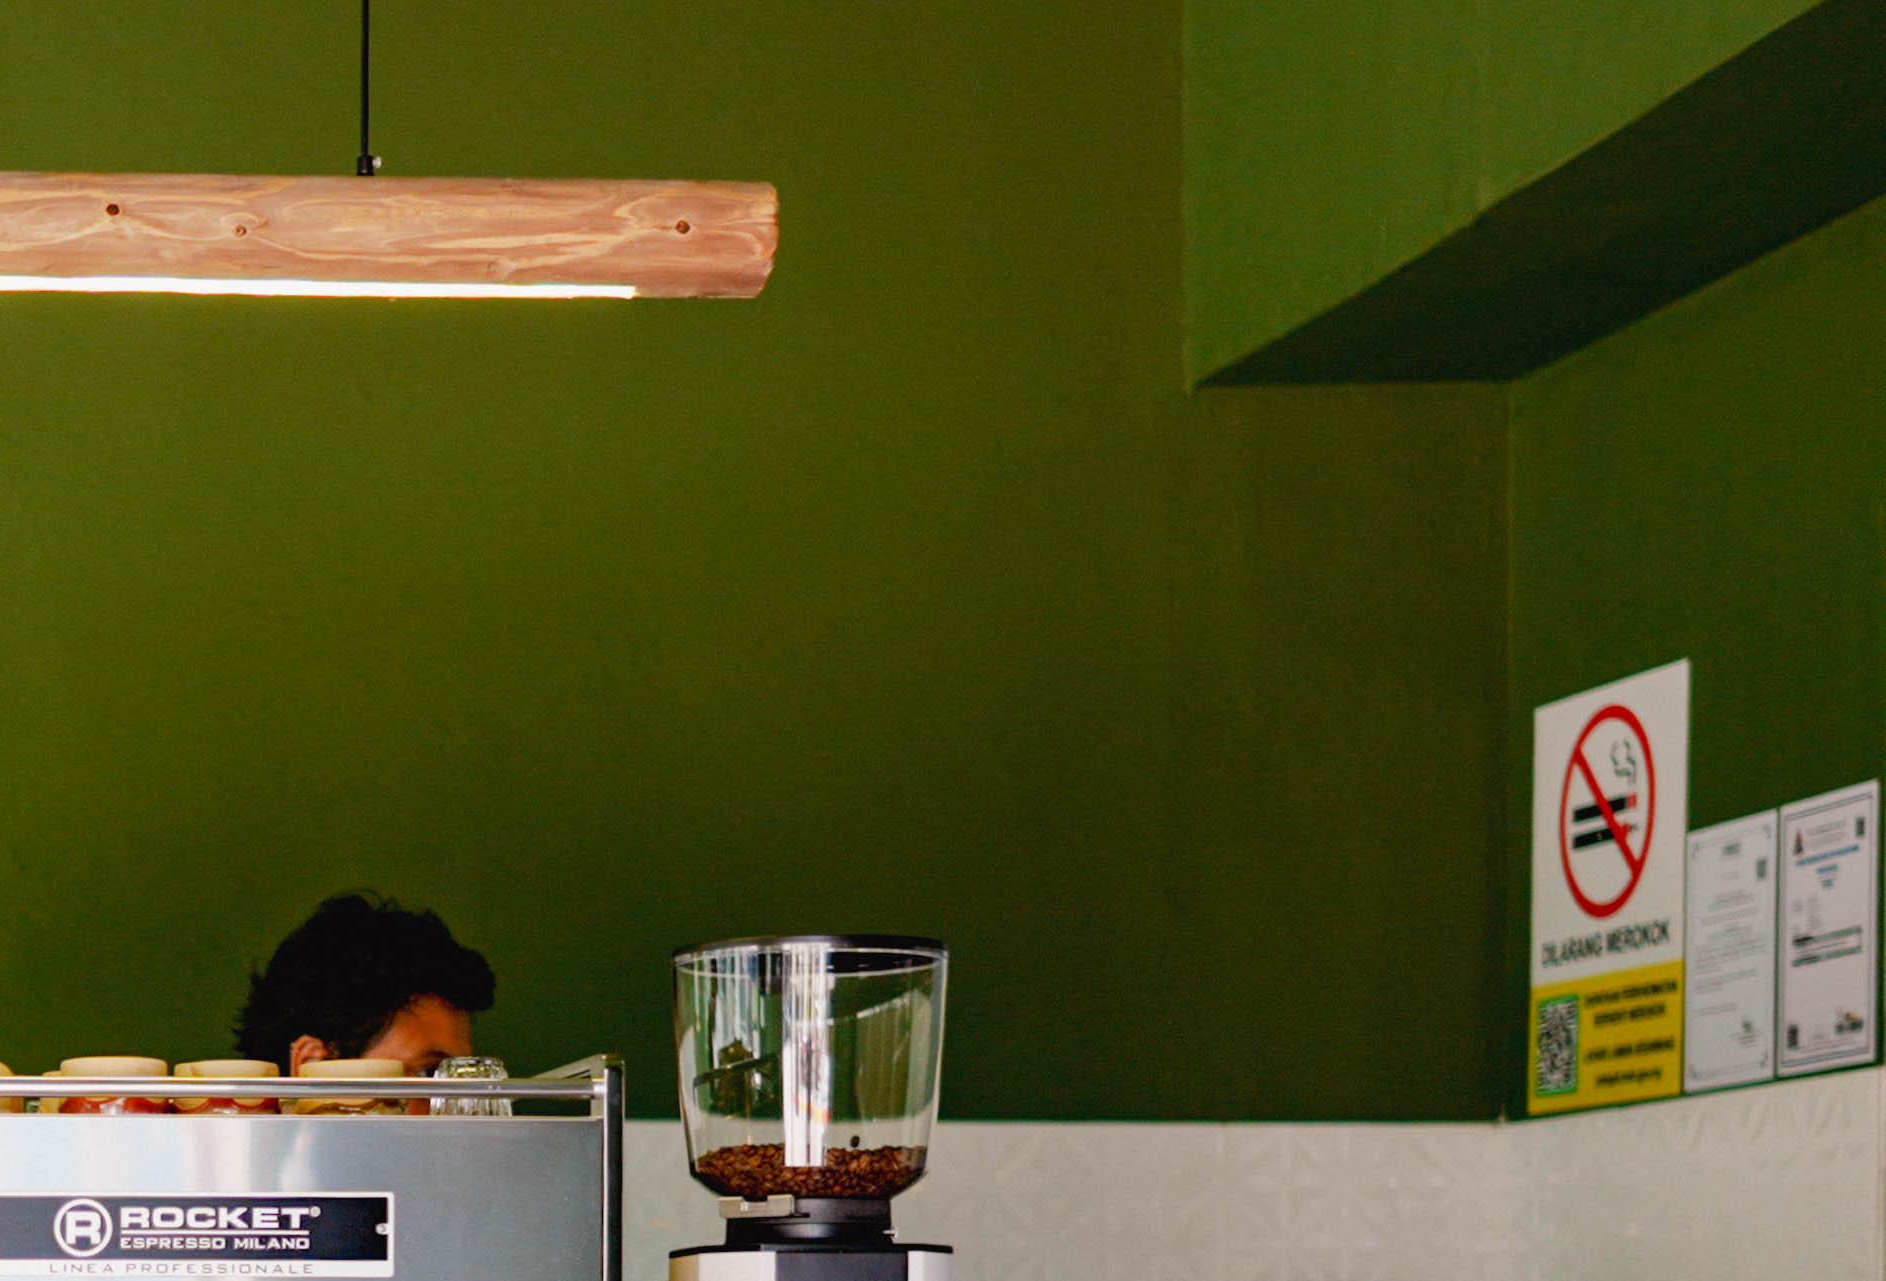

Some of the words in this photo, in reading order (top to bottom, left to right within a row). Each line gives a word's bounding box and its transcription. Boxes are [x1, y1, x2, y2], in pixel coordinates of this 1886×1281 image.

[120, 1206, 309, 1230] ROCKET
[120, 1237, 226, 1250] ESPRESSO
[233, 1237, 310, 1250] MILANO
[49, 1263, 114, 1274] LINEA
[125, 1263, 314, 1274] PROFESSIONALE
